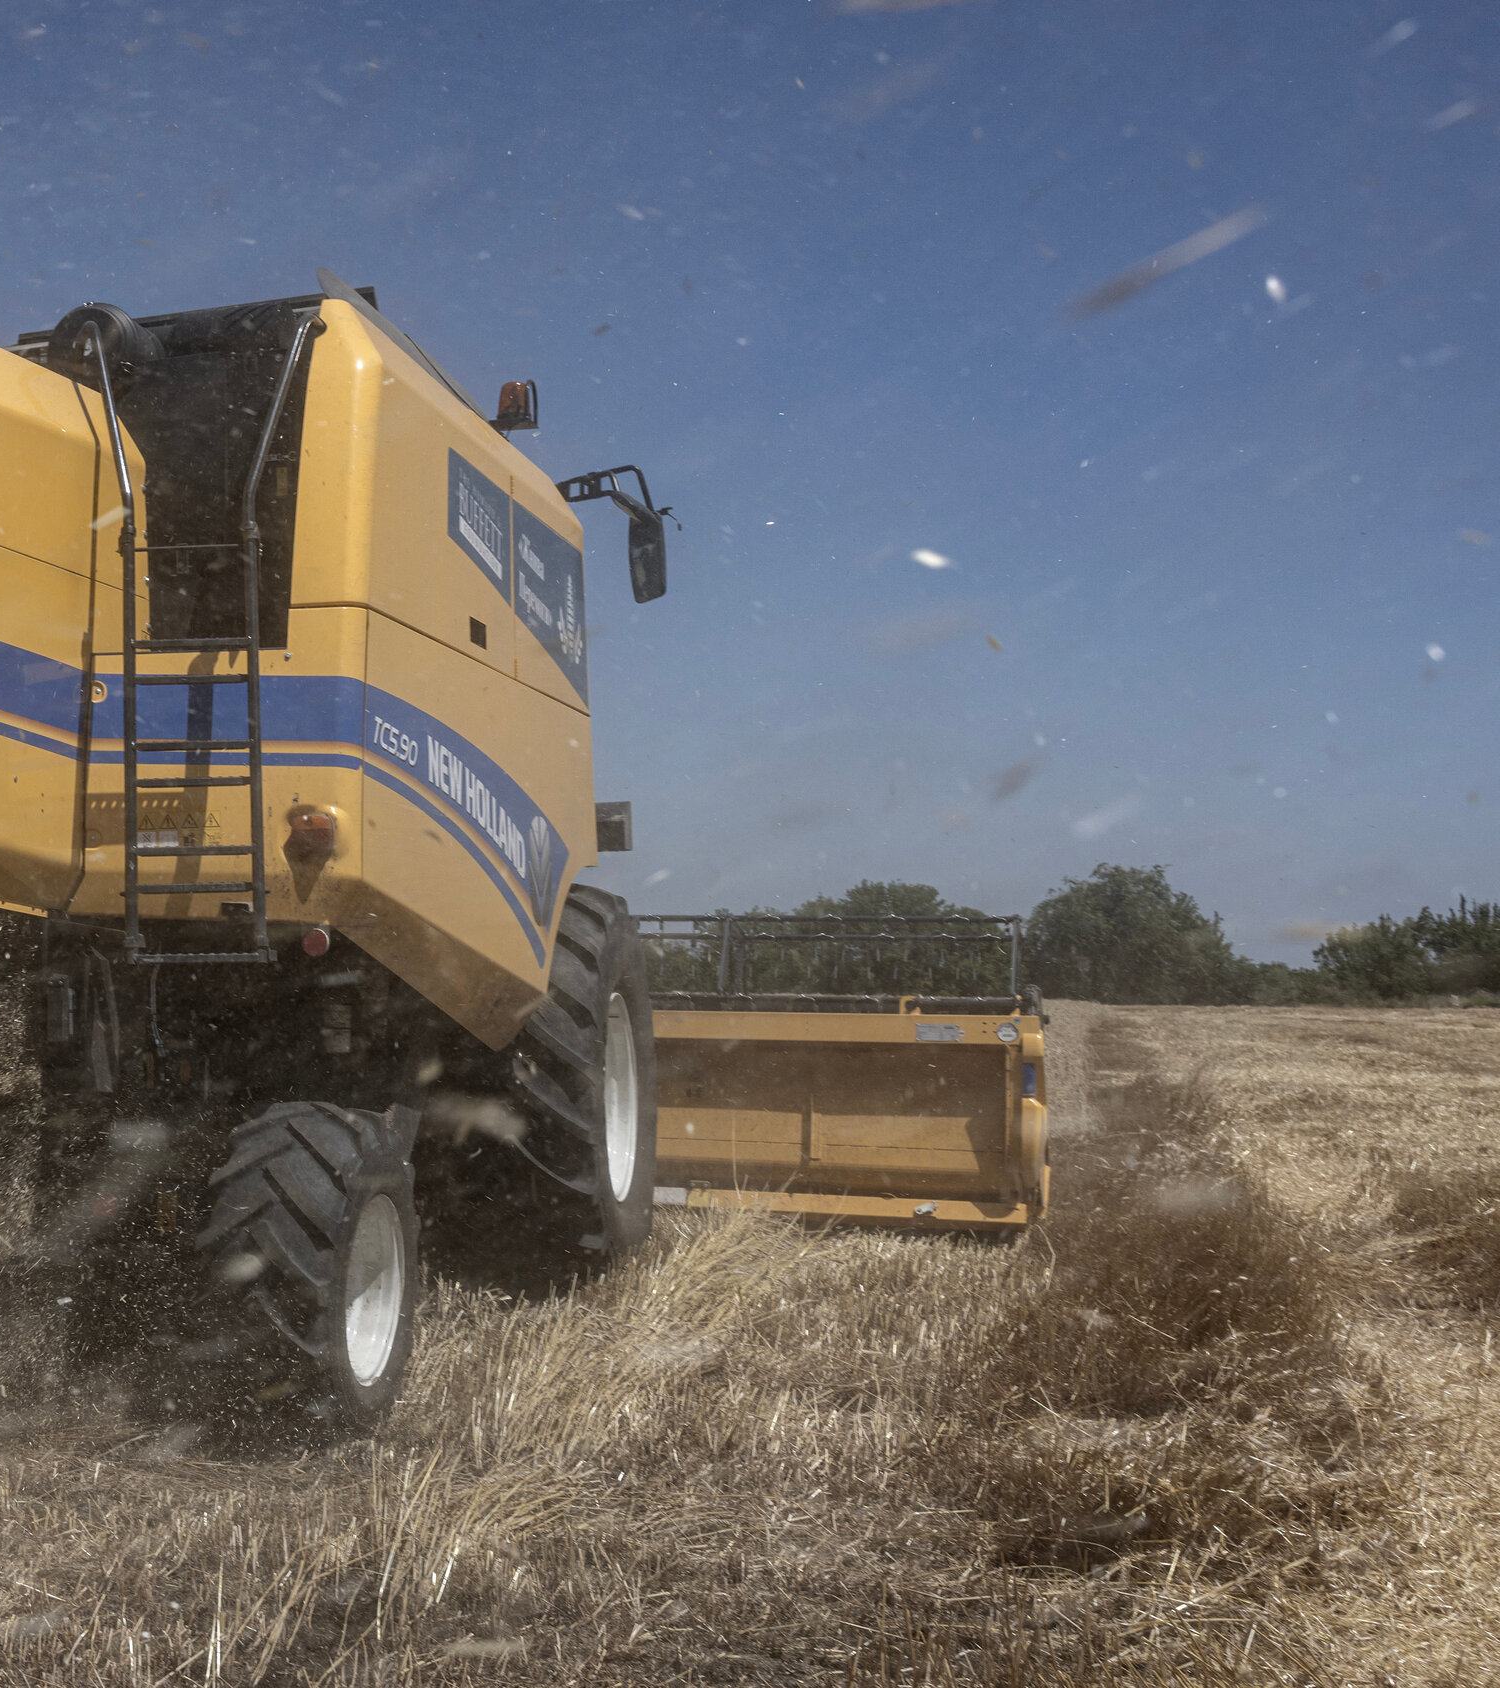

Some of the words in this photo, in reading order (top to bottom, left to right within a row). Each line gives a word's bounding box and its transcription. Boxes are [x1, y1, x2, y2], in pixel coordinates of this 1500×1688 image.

[373, 716, 418, 767] TC5.90
[427, 735, 463, 806] NEW
[465, 767, 526, 880] HOLLAND
